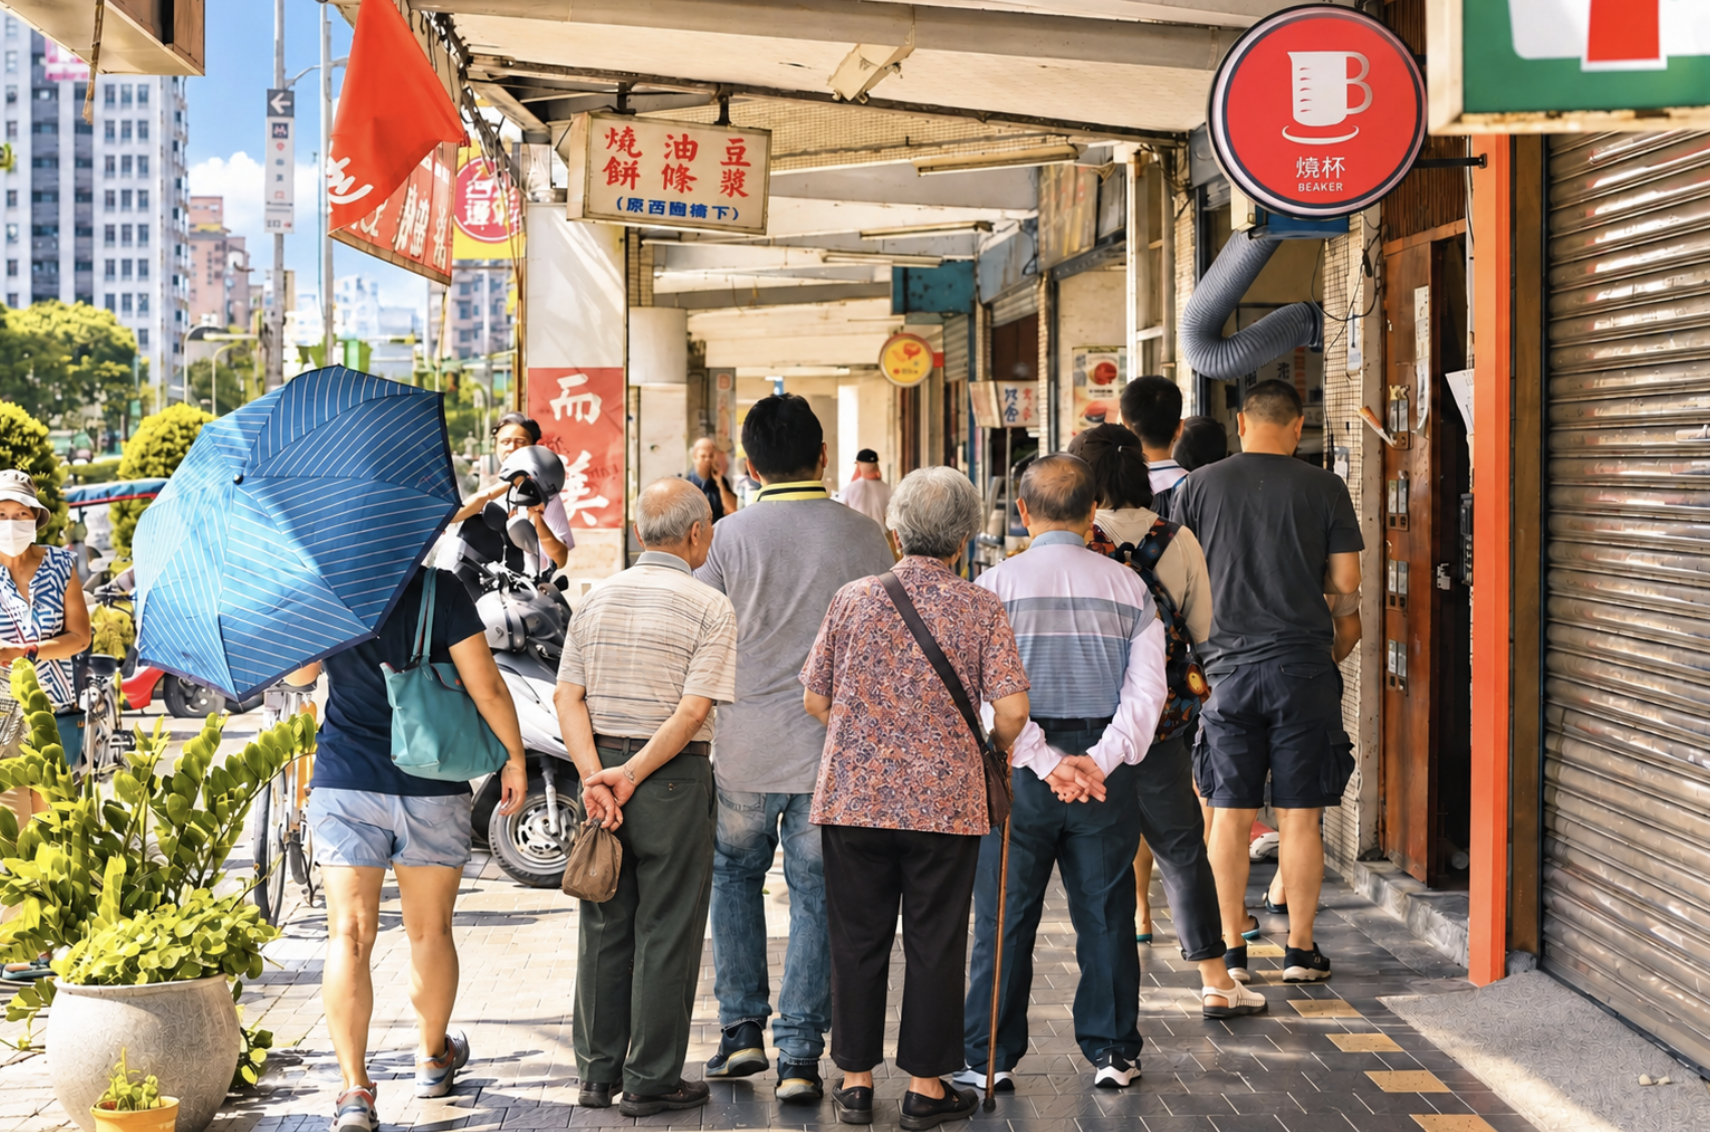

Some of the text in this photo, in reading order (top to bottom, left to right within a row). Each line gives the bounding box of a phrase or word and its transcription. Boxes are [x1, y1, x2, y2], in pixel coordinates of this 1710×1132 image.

[603, 126, 643, 190] 燒餅
[661, 133, 699, 194] 油條
[720, 138, 751, 198] 豆漿
[1296, 156, 1345, 179] 燒杯
[1298, 182, 1343, 192] BEAKER
